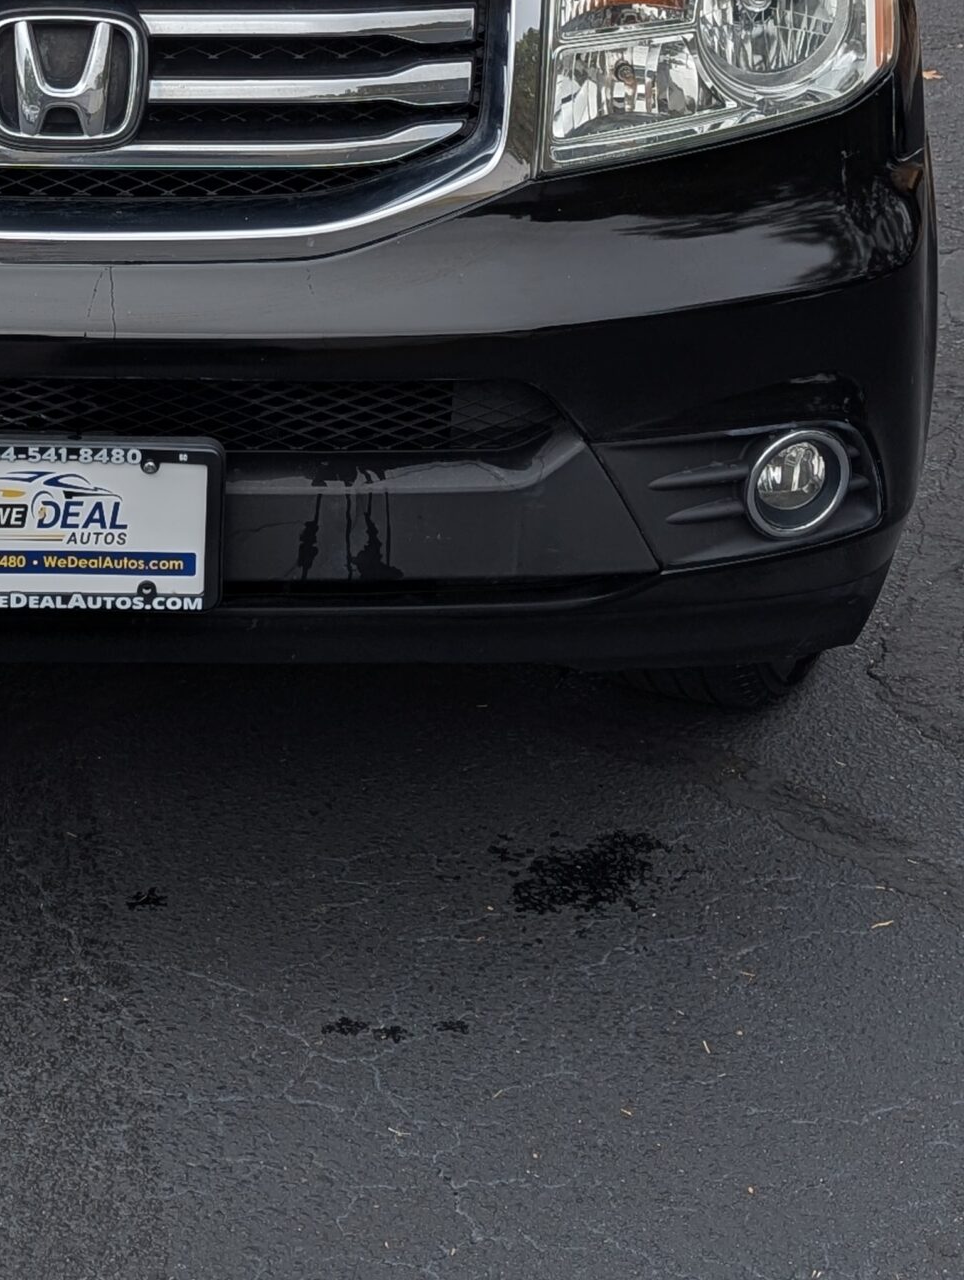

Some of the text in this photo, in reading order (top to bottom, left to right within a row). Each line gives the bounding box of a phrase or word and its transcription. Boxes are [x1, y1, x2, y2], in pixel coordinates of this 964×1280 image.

[37, 500, 128, 530] DEAL
[66, 532, 127, 546] AUTOS
[43, 555, 184, 570] WeDealAutos.com
